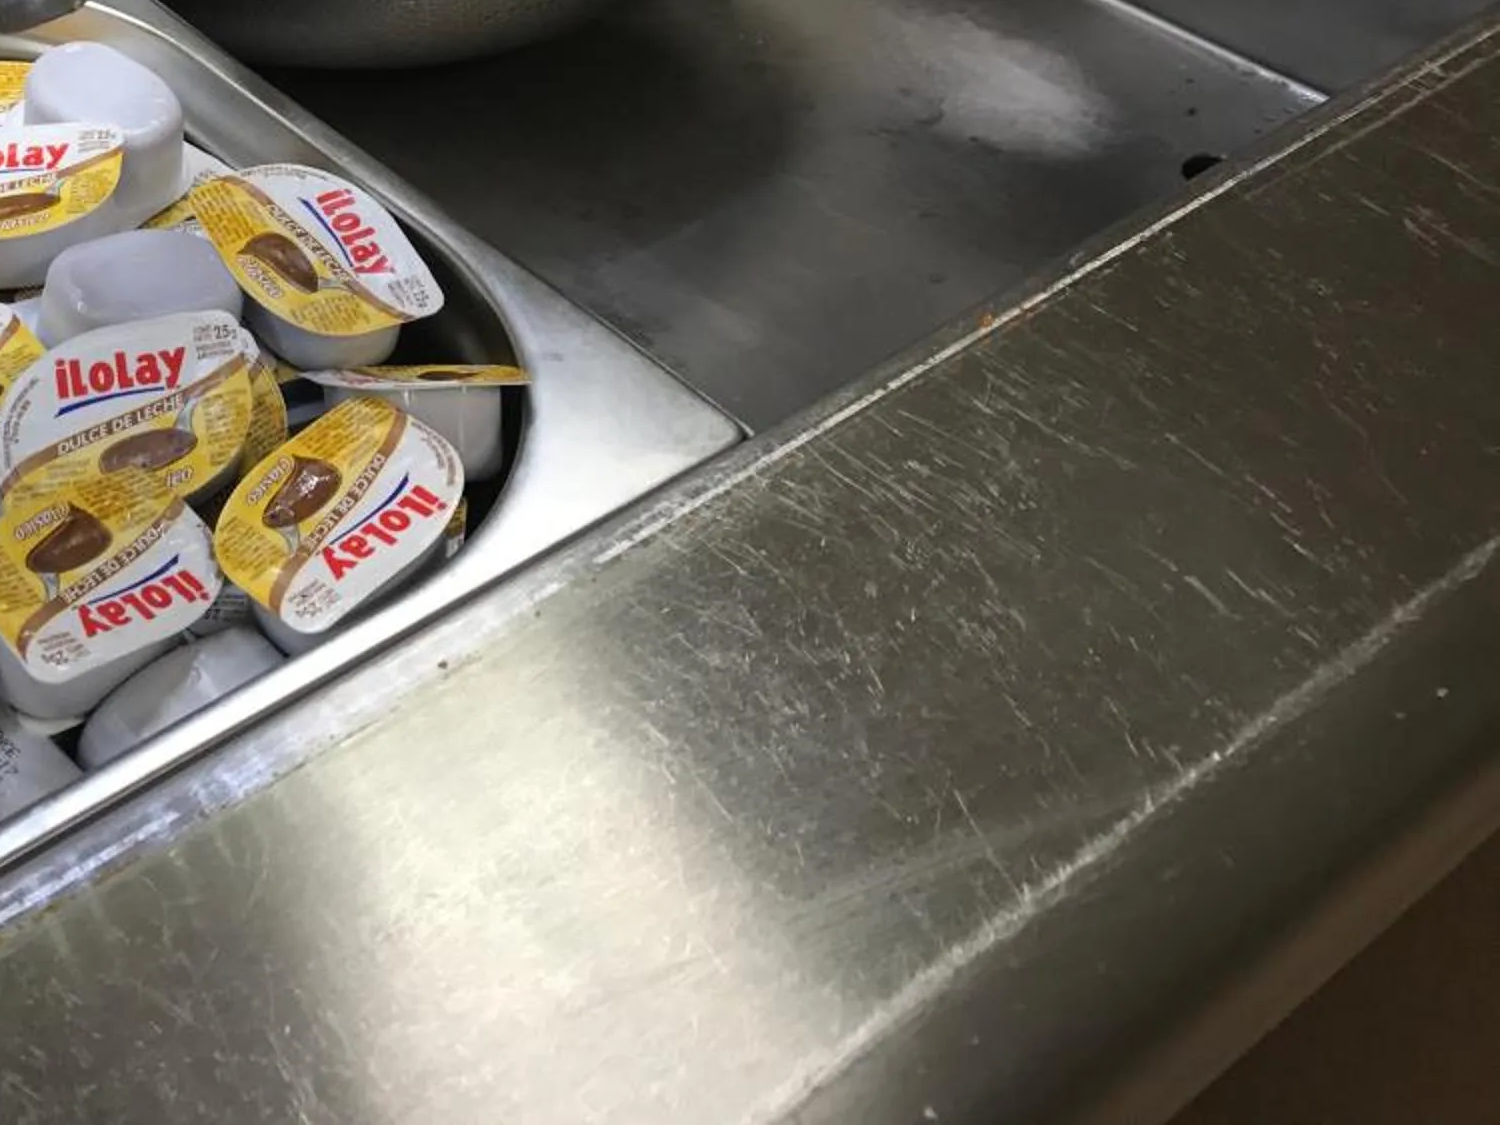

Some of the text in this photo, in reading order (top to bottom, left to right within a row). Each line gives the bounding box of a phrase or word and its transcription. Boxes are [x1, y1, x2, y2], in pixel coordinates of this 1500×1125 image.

[54, 391, 186, 457] DULCE DE LECHE
